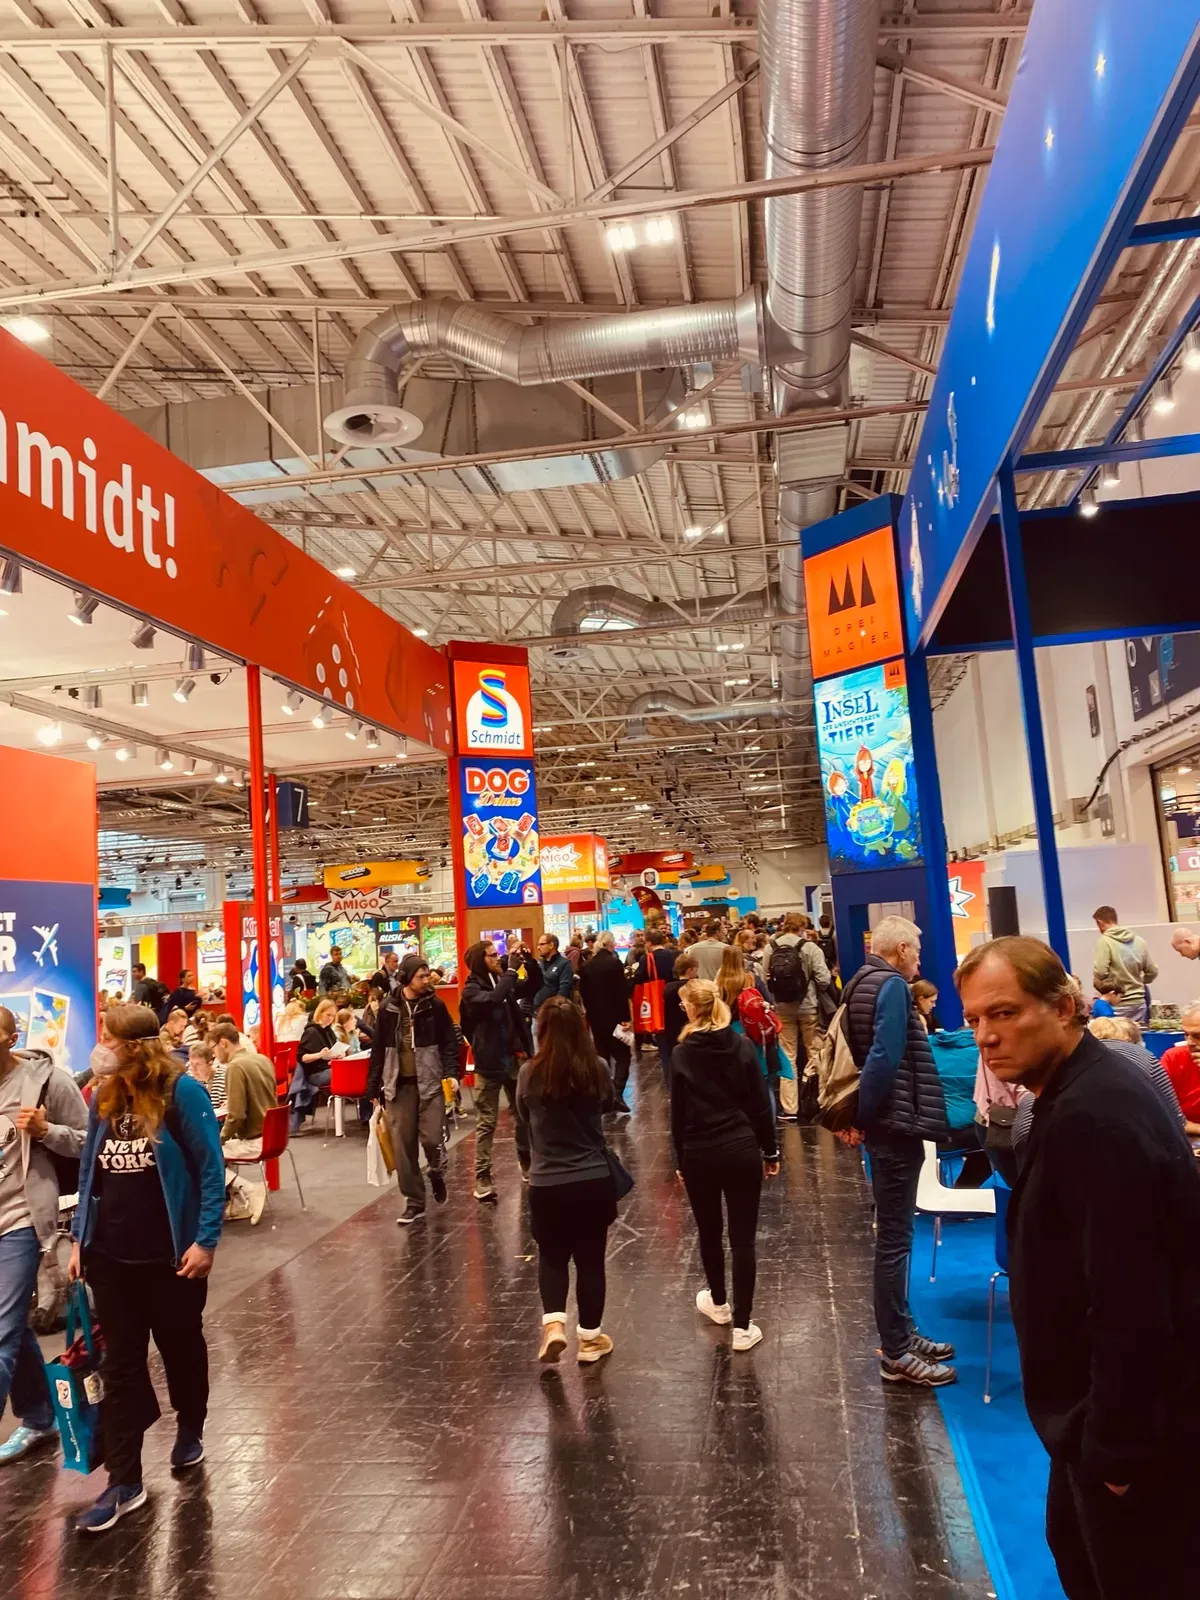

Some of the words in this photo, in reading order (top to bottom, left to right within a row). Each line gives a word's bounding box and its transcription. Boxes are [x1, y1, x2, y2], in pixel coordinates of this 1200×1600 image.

[834, 616, 875, 635] DREI
[823, 630, 890, 658] MAGIER
[821, 689, 879, 724] INSEL
[471, 729, 521, 745] Schmidt
[828, 722, 875, 744] TIERE
[465, 767, 530, 795] DOG
[478, 791, 522, 807] Deluxe
[333, 898, 379, 911] AMIGO
[102, 1137, 149, 1154] NEW
[98, 1152, 156, 1169] YORK
